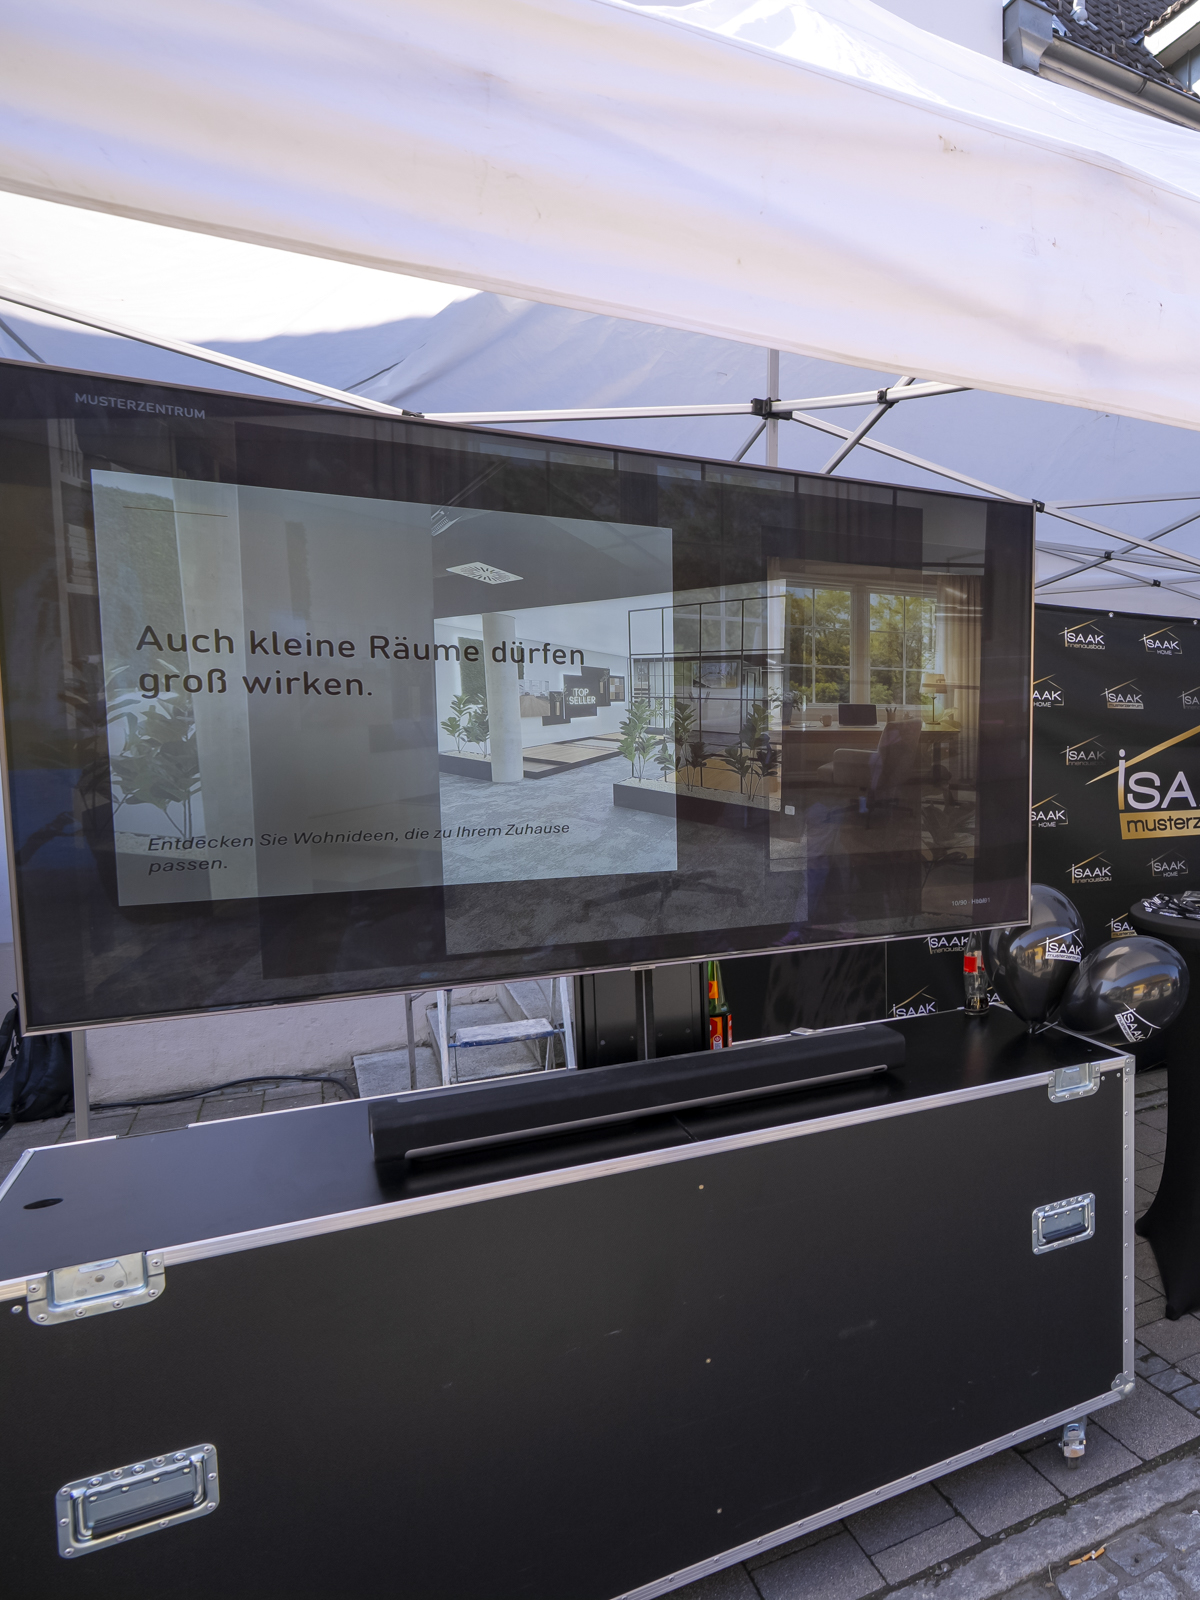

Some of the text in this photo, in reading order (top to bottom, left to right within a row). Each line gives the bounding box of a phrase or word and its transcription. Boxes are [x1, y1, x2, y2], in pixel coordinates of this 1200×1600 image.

[74, 392, 206, 420] MUSTERZENTRUM
[135, 624, 586, 667] Auch kleine Räume dürfen
[138, 668, 374, 700] groß wirken.
[572, 688, 590, 697] TOP
[569, 696, 597, 705] SELLER
[147, 822, 571, 853] Entdecken Sie Wohnideen, die zu Ihrem Zuhause
[147, 857, 229, 876] passen.
